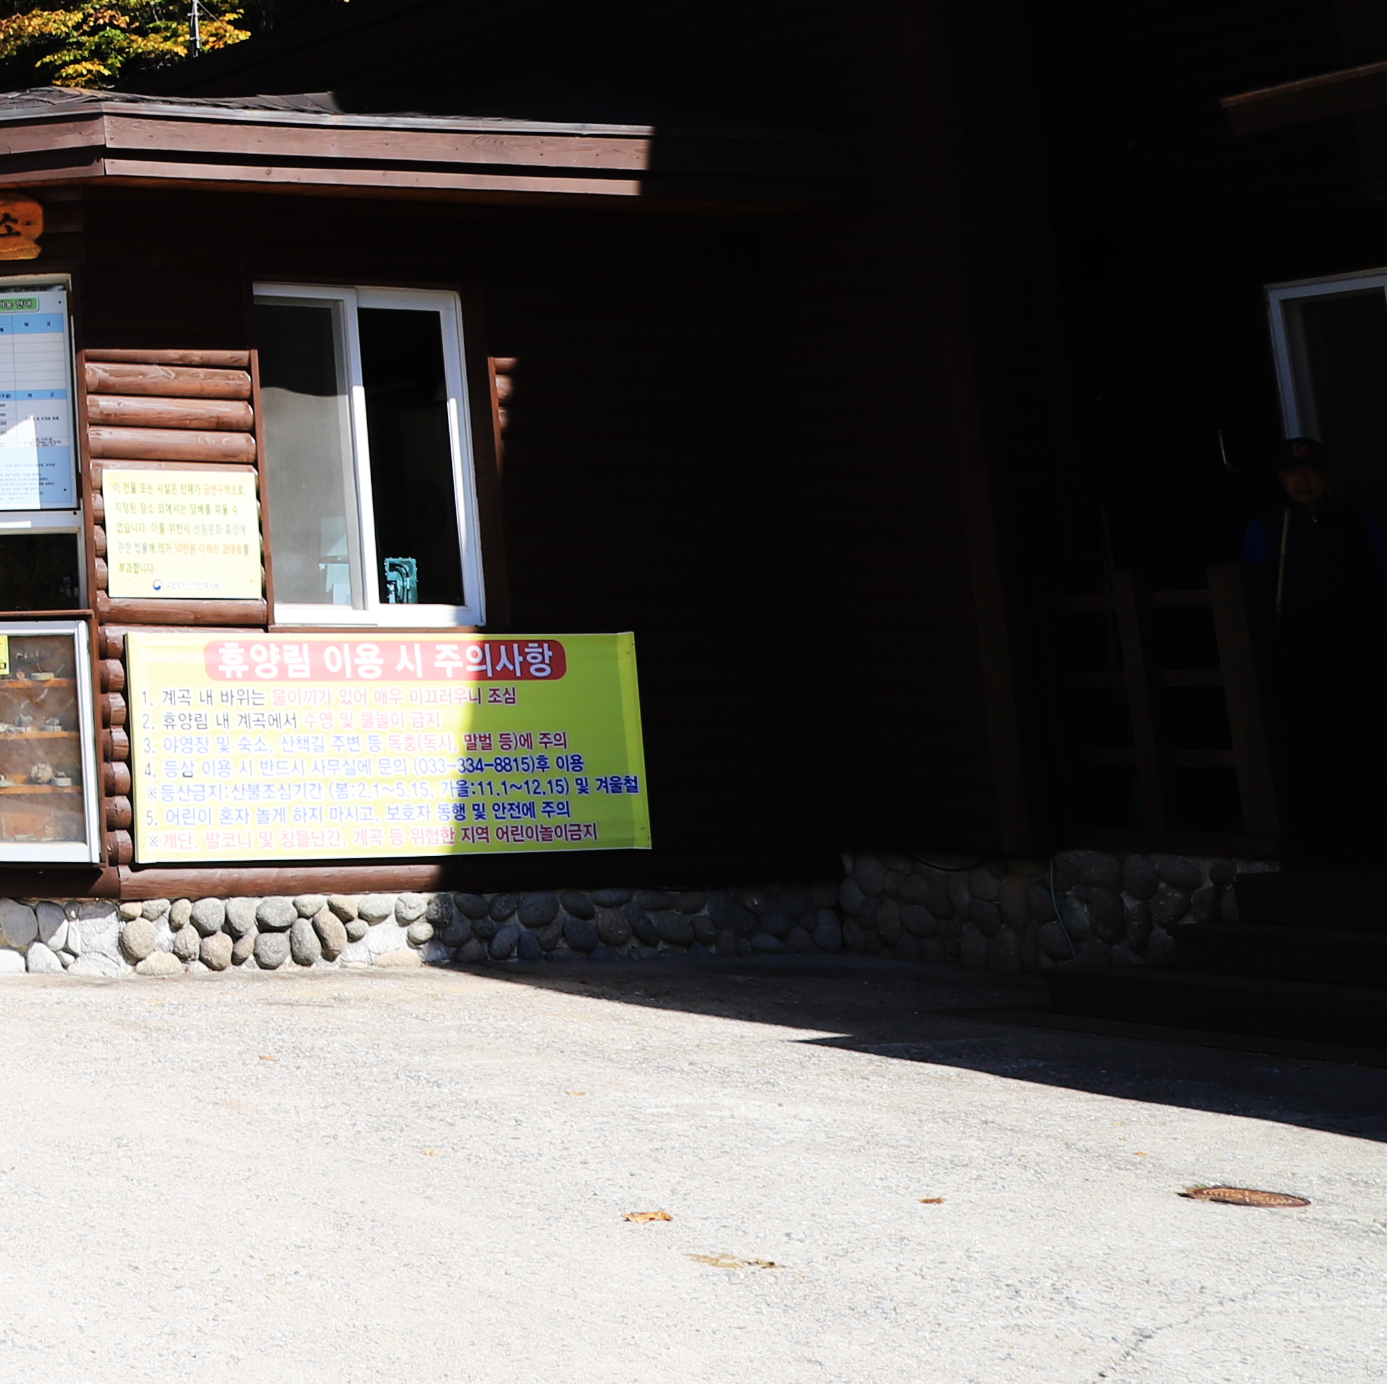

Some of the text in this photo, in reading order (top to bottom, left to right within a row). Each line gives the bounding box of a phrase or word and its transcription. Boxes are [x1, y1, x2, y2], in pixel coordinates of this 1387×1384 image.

[217, 642, 553, 679] 휴양림 이용 시 주의사항
[162, 689, 192, 706] 계곡
[199, 689, 213, 706] 내
[220, 688, 266, 706] 바위는
[272, 688, 332, 706] 물이끼가
[338, 688, 367, 706] 있어
[374, 688, 404, 705] 매우
[410, 687, 482, 706] 미끄러우니
[488, 686, 516, 705] 조심
[163, 712, 208, 730] 휴양림
[216, 712, 230, 729] 내
[237, 712, 297, 730] 계곡에서
[304, 711, 333, 729] 수영
[340, 711, 354, 729] 및
[360, 711, 405, 729] 물놀이
[410, 711, 441, 728] 금지
[163, 735, 210, 754] 야영장
[217, 735, 230, 753] 및
[237, 735, 273, 754] 숙소,
[280, 735, 325, 753] 산책길
[331, 734, 361, 753] 주변
[367, 734, 382, 752] 등
[464, 732, 493, 751] 말벌
[498, 732, 533, 751] 등)에
[538, 731, 567, 749] 주의
[202, 760, 231, 777] 이용
[239, 759, 253, 777] 시
[260, 759, 306, 777] 반드시
[312, 758, 371, 776] 사무실에
[378, 757, 407, 775] 문의
[556, 753, 584, 772] 이용
[575, 777, 589, 795] 및
[595, 775, 639, 794] 겨울철
[166, 808, 212, 825] 어린이
[219, 807, 249, 825] 혼자
[256, 807, 286, 824] 놀게
[293, 806, 323, 824] 하지
[329, 806, 380, 824] 마시고,
[386, 804, 431, 822] 보호자
[437, 803, 466, 821] 동행
[472, 802, 486, 820] 및
[492, 801, 536, 820] 안전에
[541, 800, 571, 818] 주의
[206, 831, 252, 849] 발코니
[259, 830, 273, 848] 및
[281, 830, 347, 848] 창틀난간,
[354, 829, 383, 846] 계곡
[389, 828, 404, 846] 등
[411, 826, 455, 845] 위험한
[461, 825, 490, 844] 지역
[496, 823, 597, 843] 어린이놀이금지
